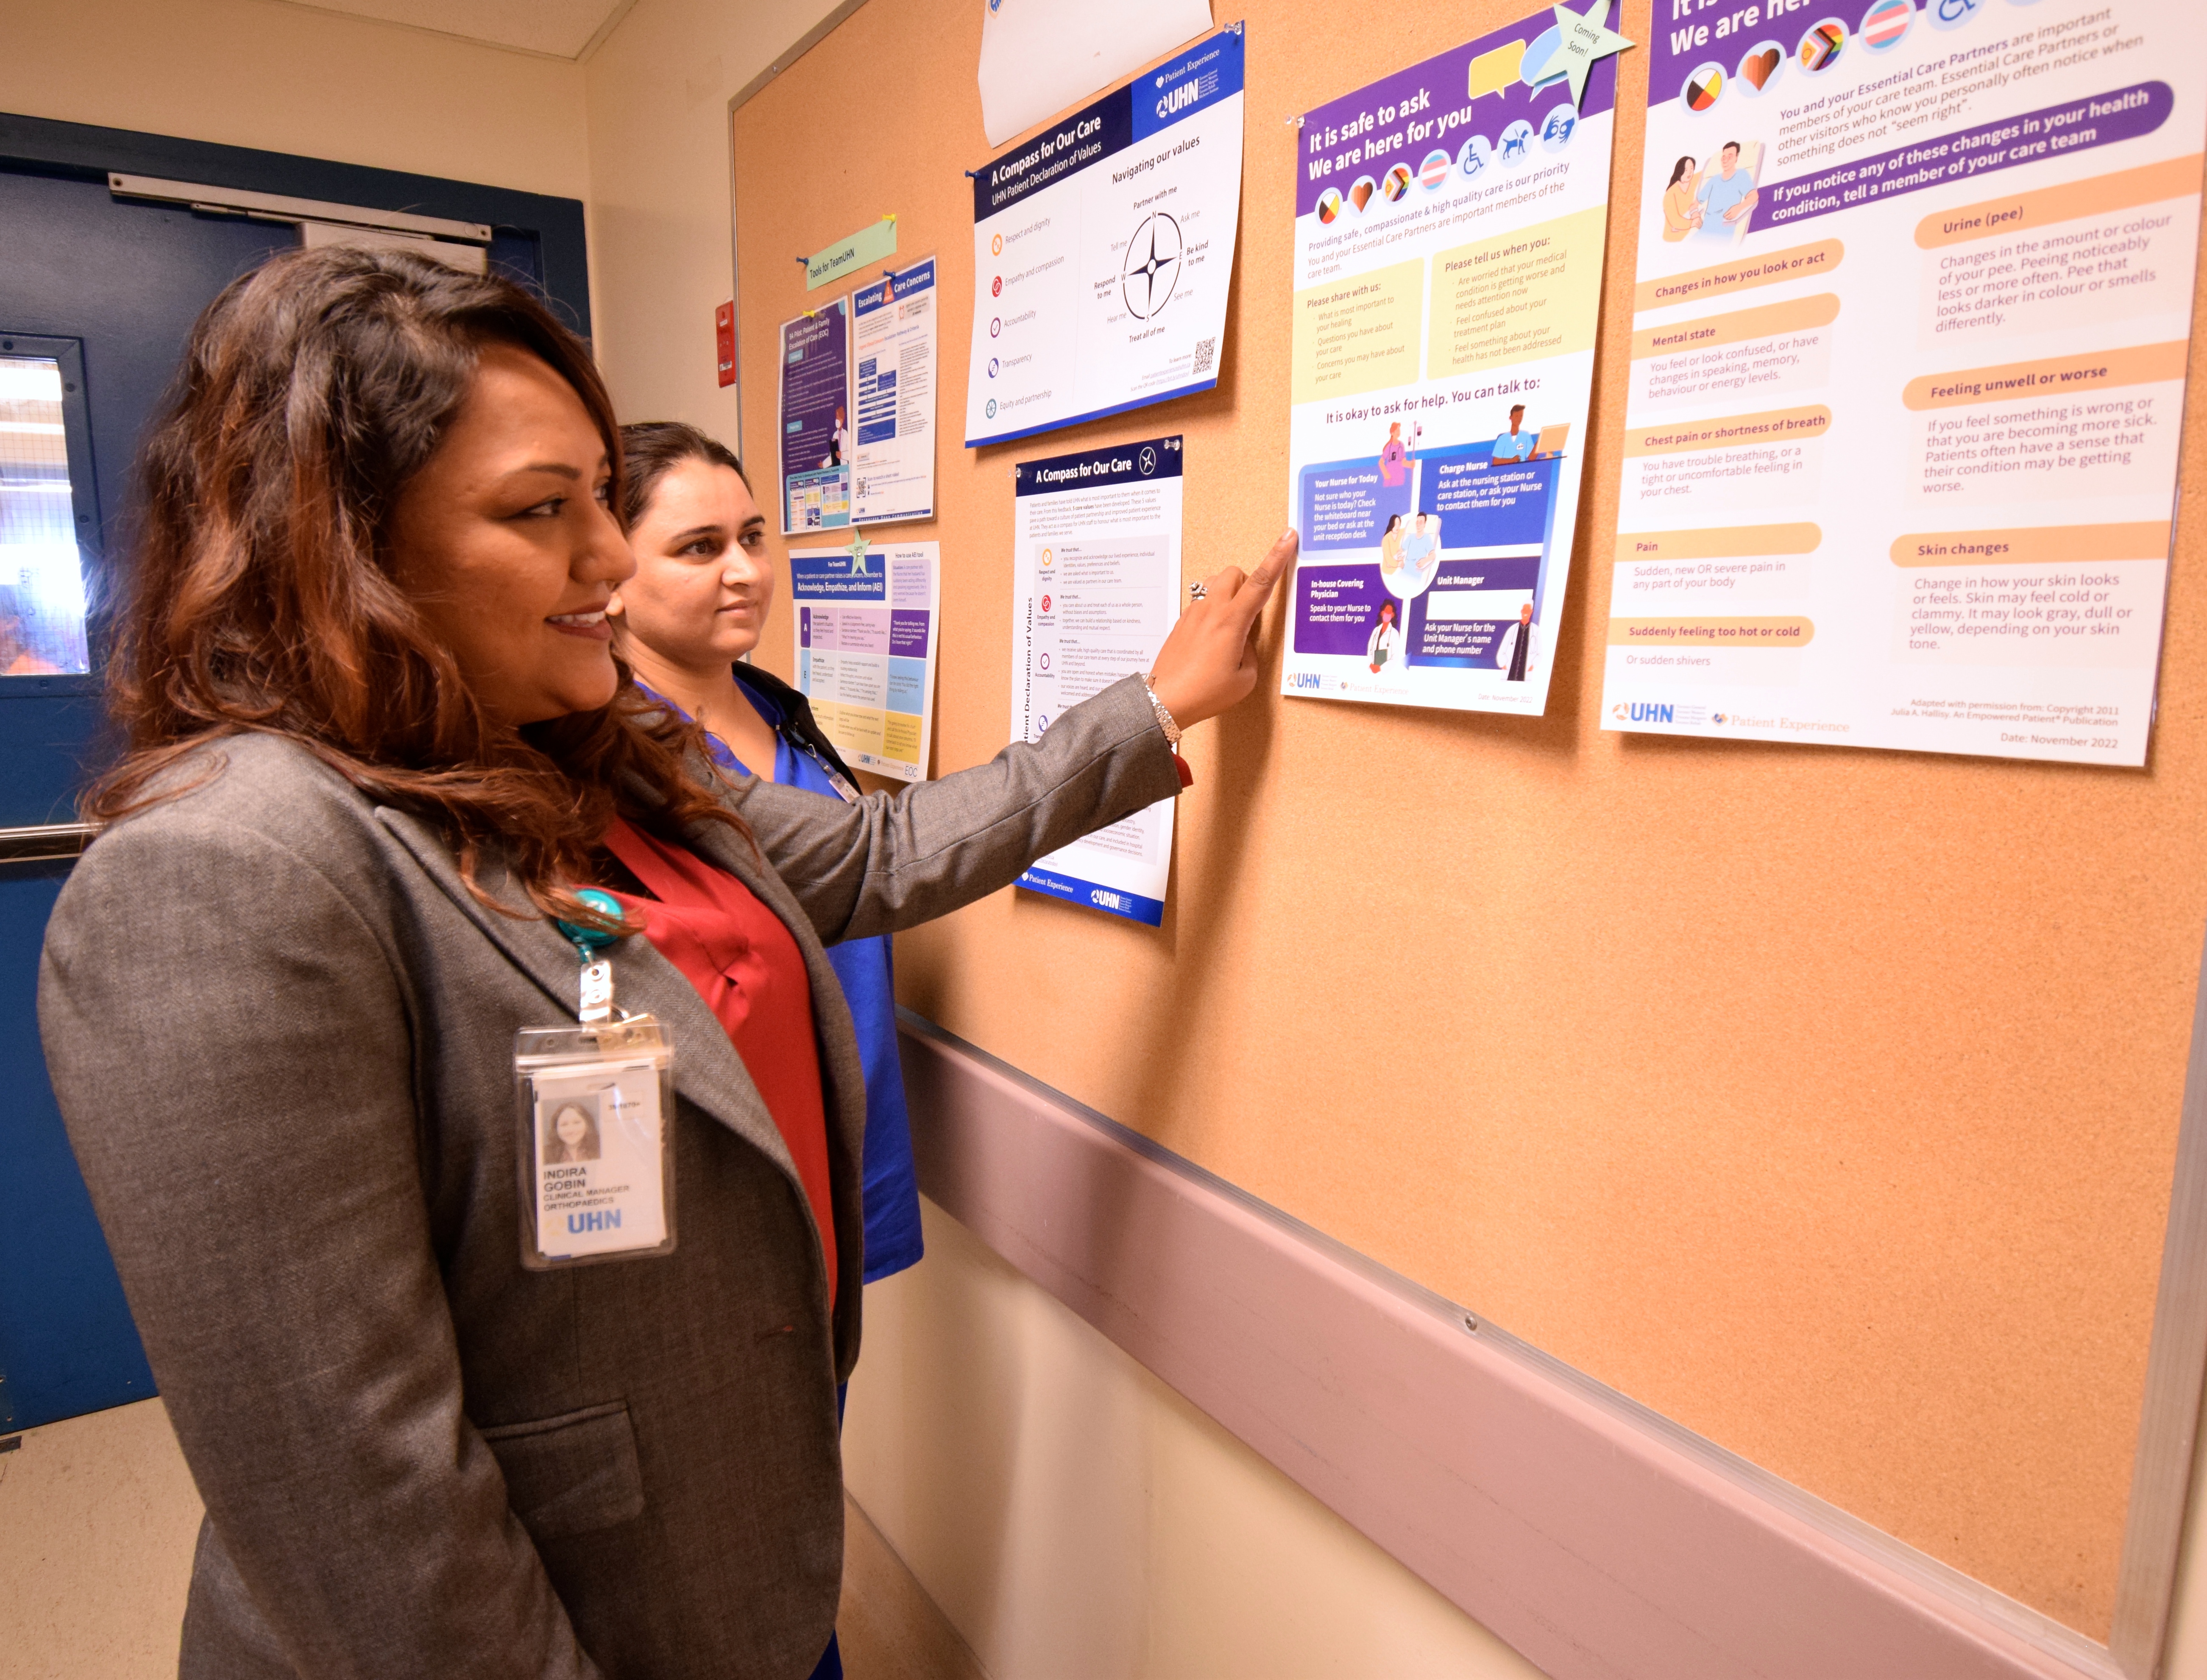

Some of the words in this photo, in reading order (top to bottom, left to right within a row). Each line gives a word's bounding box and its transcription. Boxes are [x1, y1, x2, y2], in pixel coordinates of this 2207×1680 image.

[1574, 23, 1600, 44] Coming
[1670, 25, 1709, 56] We
[1715, 6, 1760, 39] are
[1568, 41, 1588, 57] Soon!
[1165, 67, 1185, 83] Patient
[1187, 50, 1219, 71] Experience
[1169, 78, 1198, 114] UHN
[1310, 133, 1321, 153] It
[1326, 127, 1337, 147] is
[1341, 112, 1374, 141] safe
[1378, 106, 1395, 125] to
[1400, 90, 1430, 117] ask
[992, 170, 998, 186] A
[1000, 150, 1039, 181] Compass
[1041, 142, 1054, 159] for
[1057, 130, 1075, 150] Our
[1078, 117, 1101, 139] Care
[1310, 158, 1332, 180] We
[1335, 148, 1361, 171] are
[1365, 132, 1403, 160] here
[1407, 120, 1433, 144] for
[1438, 106, 1471, 139] you
[1774, 186, 1784, 202] If
[1785, 183, 1811, 201] you
[1814, 170, 1856, 191] notice
[1859, 162, 1885, 178] any
[1888, 152, 1904, 170] of
[1906, 144, 1948, 165] these
[1952, 125, 2019, 153] changes
[2024, 119, 2040, 134] in
[2044, 108, 2085, 133] your
[2090, 91, 2148, 118] health
[1113, 158, 1154, 185] Navigating
[1157, 150, 1170, 164] our
[1173, 136, 1199, 156] values
[993, 189, 1006, 205] UHN
[1008, 178, 1028, 198] Patient
[1031, 159, 1067, 186] Declaration
[1070, 153, 1076, 165] of
[1078, 142, 1101, 161] Values
[1772, 196, 1840, 221] condition,
[1844, 184, 1866, 202] tell
[1870, 184, 1878, 195] a
[1882, 166, 1945, 192] member
[1948, 157, 1965, 175] of
[1968, 150, 2006, 174] your
[2010, 141, 2046, 159] care
[2051, 129, 2096, 149] team
[1944, 218, 1981, 234] Urine
[1986, 206, 2023, 227] (pee)
[1006, 230, 1023, 244] Respect
[1024, 223, 1032, 236] and
[1034, 218, 1050, 231] dignity
[810, 266, 822, 279] Tools
[830, 248, 854, 268] TeamUHN
[1446, 259, 1472, 272] Please
[1475, 251, 1488, 264] tell
[1491, 251, 1500, 260] us
[1503, 243, 1527, 256] when
[1530, 237, 1550, 252] you:
[1006, 272, 1025, 286] Empathy
[1026, 266, 1034, 277] and
[1036, 256, 1064, 273] compassion
[1656, 282, 1699, 298] Changes
[1702, 278, 1711, 288] in
[1714, 273, 1737, 285] how
[1740, 268, 1760, 282] you
[1764, 260, 1788, 274] look
[1792, 258, 1804, 268] or
[1807, 252, 1825, 264] act
[895, 282, 905, 293] Care
[907, 272, 930, 287] Concerns
[859, 292, 882, 308] Escalating
[1307, 297, 1329, 309] Please
[1331, 291, 1350, 303] share
[1352, 285, 1368, 297] with
[1371, 283, 1381, 292] us:
[1004, 310, 1036, 328] Accountability
[1653, 331, 1687, 347] Mental
[1690, 328, 1715, 340] state
[1002, 354, 1032, 368] Transparency
[1931, 383, 1981, 398] Feeling
[1985, 373, 2035, 391] unwell
[2040, 374, 2056, 384] or
[2060, 367, 2107, 381] worse
[1000, 400, 1014, 411] Equity
[1015, 395, 1024, 406] and
[1025, 389, 1051, 406] partnership
[1645, 435, 1673, 446] Chest
[1676, 431, 1698, 445] pain
[1701, 432, 1713, 440] or
[1715, 424, 1769, 438] shortness
[1772, 420, 1784, 431] of
[1787, 415, 1828, 432] breath
[1037, 471, 1042, 483] A
[1044, 468, 1078, 483] Compass
[1080, 463, 1092, 476] for
[1093, 461, 1109, 475] Our
[1112, 459, 1131, 472] Care
[1349, 476, 1358, 484] for
[1359, 474, 1378, 483] Today
[1637, 542, 1658, 551] Pain
[1918, 544, 1947, 556] Skin
[1951, 543, 2009, 556] changes
[798, 582, 825, 593] Acknowledge,
[825, 582, 847, 593] Empathize,
[858, 582, 872, 591] Inform
[873, 582, 882, 592] (AEI)
[1438, 576, 1452, 585] Unit
[1454, 576, 1484, 586] Manager
[1026, 636, 1031, 647] of
[1297, 674, 1321, 689] UHN
[1350, 682, 1371, 692] Patient
[1374, 684, 1409, 695] Experience
[1631, 703, 1674, 724] UHN
[1731, 715, 1774, 728] Patient
[1780, 717, 1850, 732] Experience
[2001, 732, 2027, 743] Date:
[2031, 735, 2088, 746] November
[2091, 738, 2118, 748] 2022
[861, 754, 870, 764] UHN
[905, 765, 917, 777] EOC
[1029, 873, 1045, 885] Patient
[1047, 879, 1073, 893] Experience
[1099, 890, 1120, 909] UHN
[544, 1167, 586, 1179] INDIRA
[543, 1192, 581, 1202] CLINICAL
[587, 1185, 629, 1195] MANAGER
[544, 1179, 585, 1192] GOBIN
[544, 1197, 613, 1211] ORTHOPAEDICS
[567, 1208, 621, 1234] UHN
